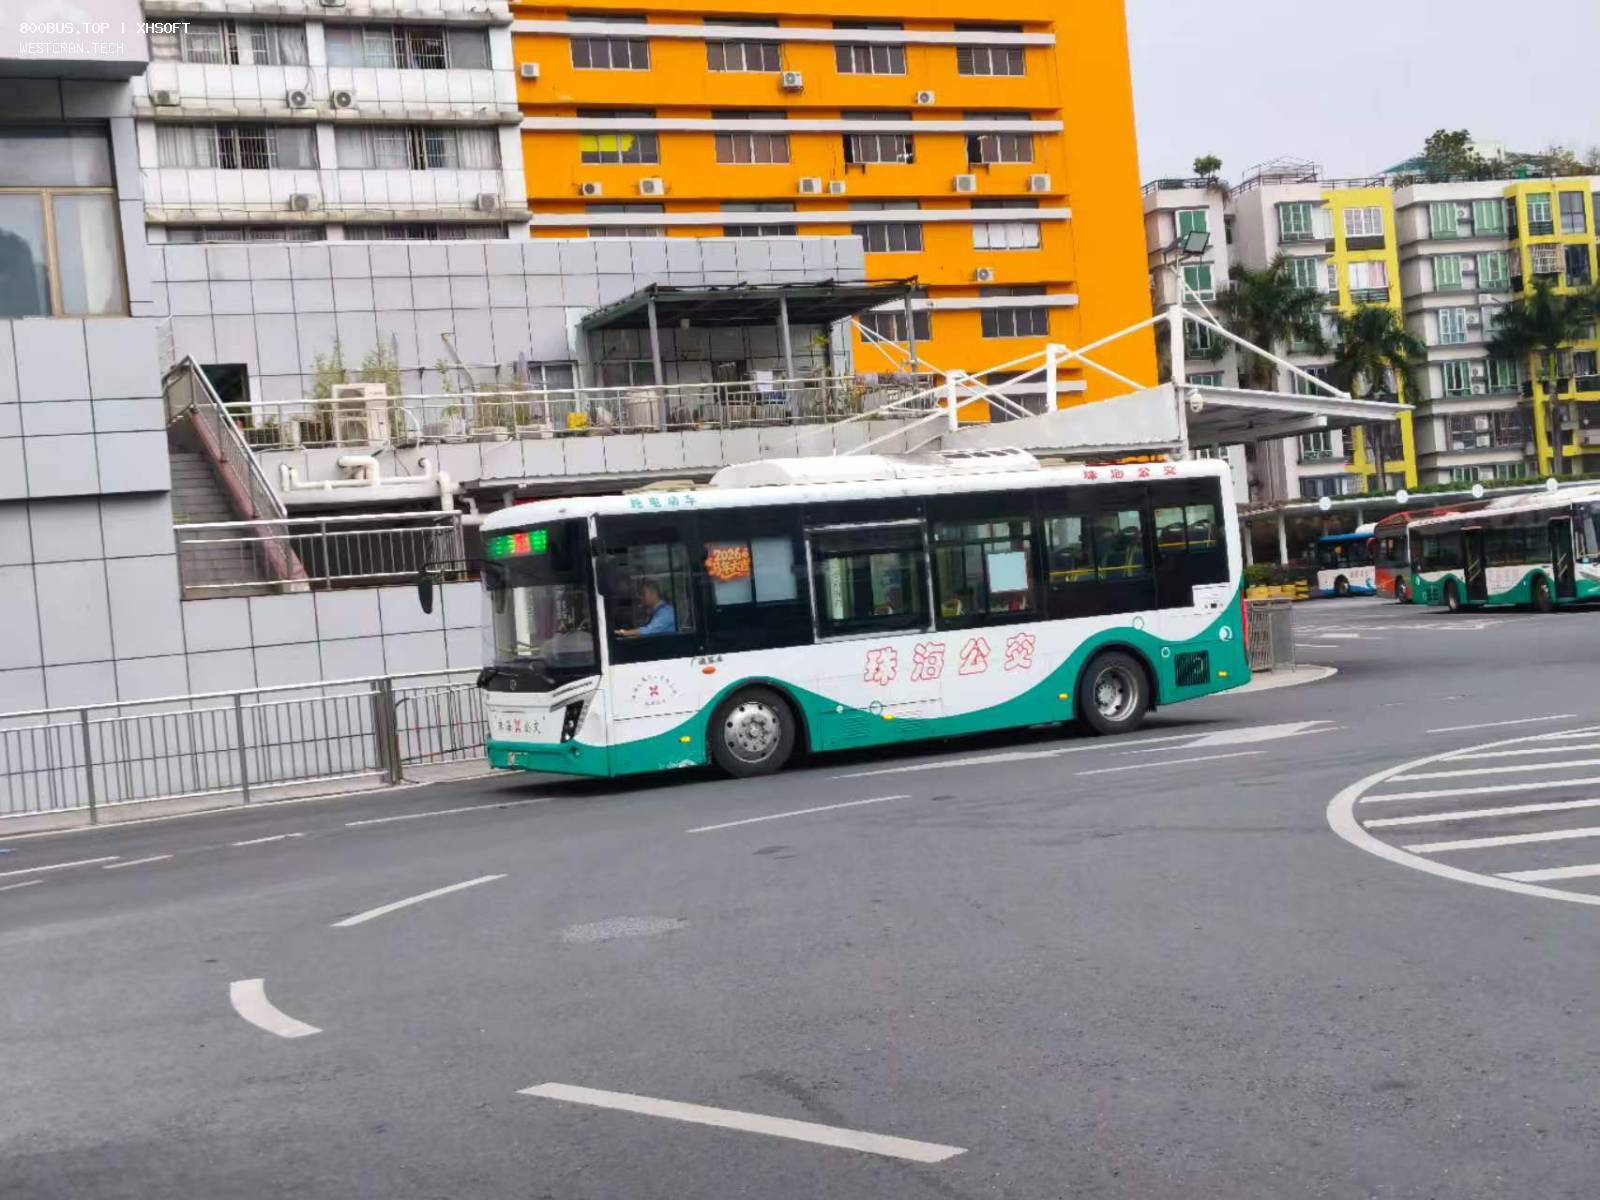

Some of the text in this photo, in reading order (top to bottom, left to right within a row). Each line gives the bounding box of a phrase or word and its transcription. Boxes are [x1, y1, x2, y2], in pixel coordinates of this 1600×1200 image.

[1083, 465, 1177, 480] 珠海公交
[864, 633, 1036, 686] 珠海公交
